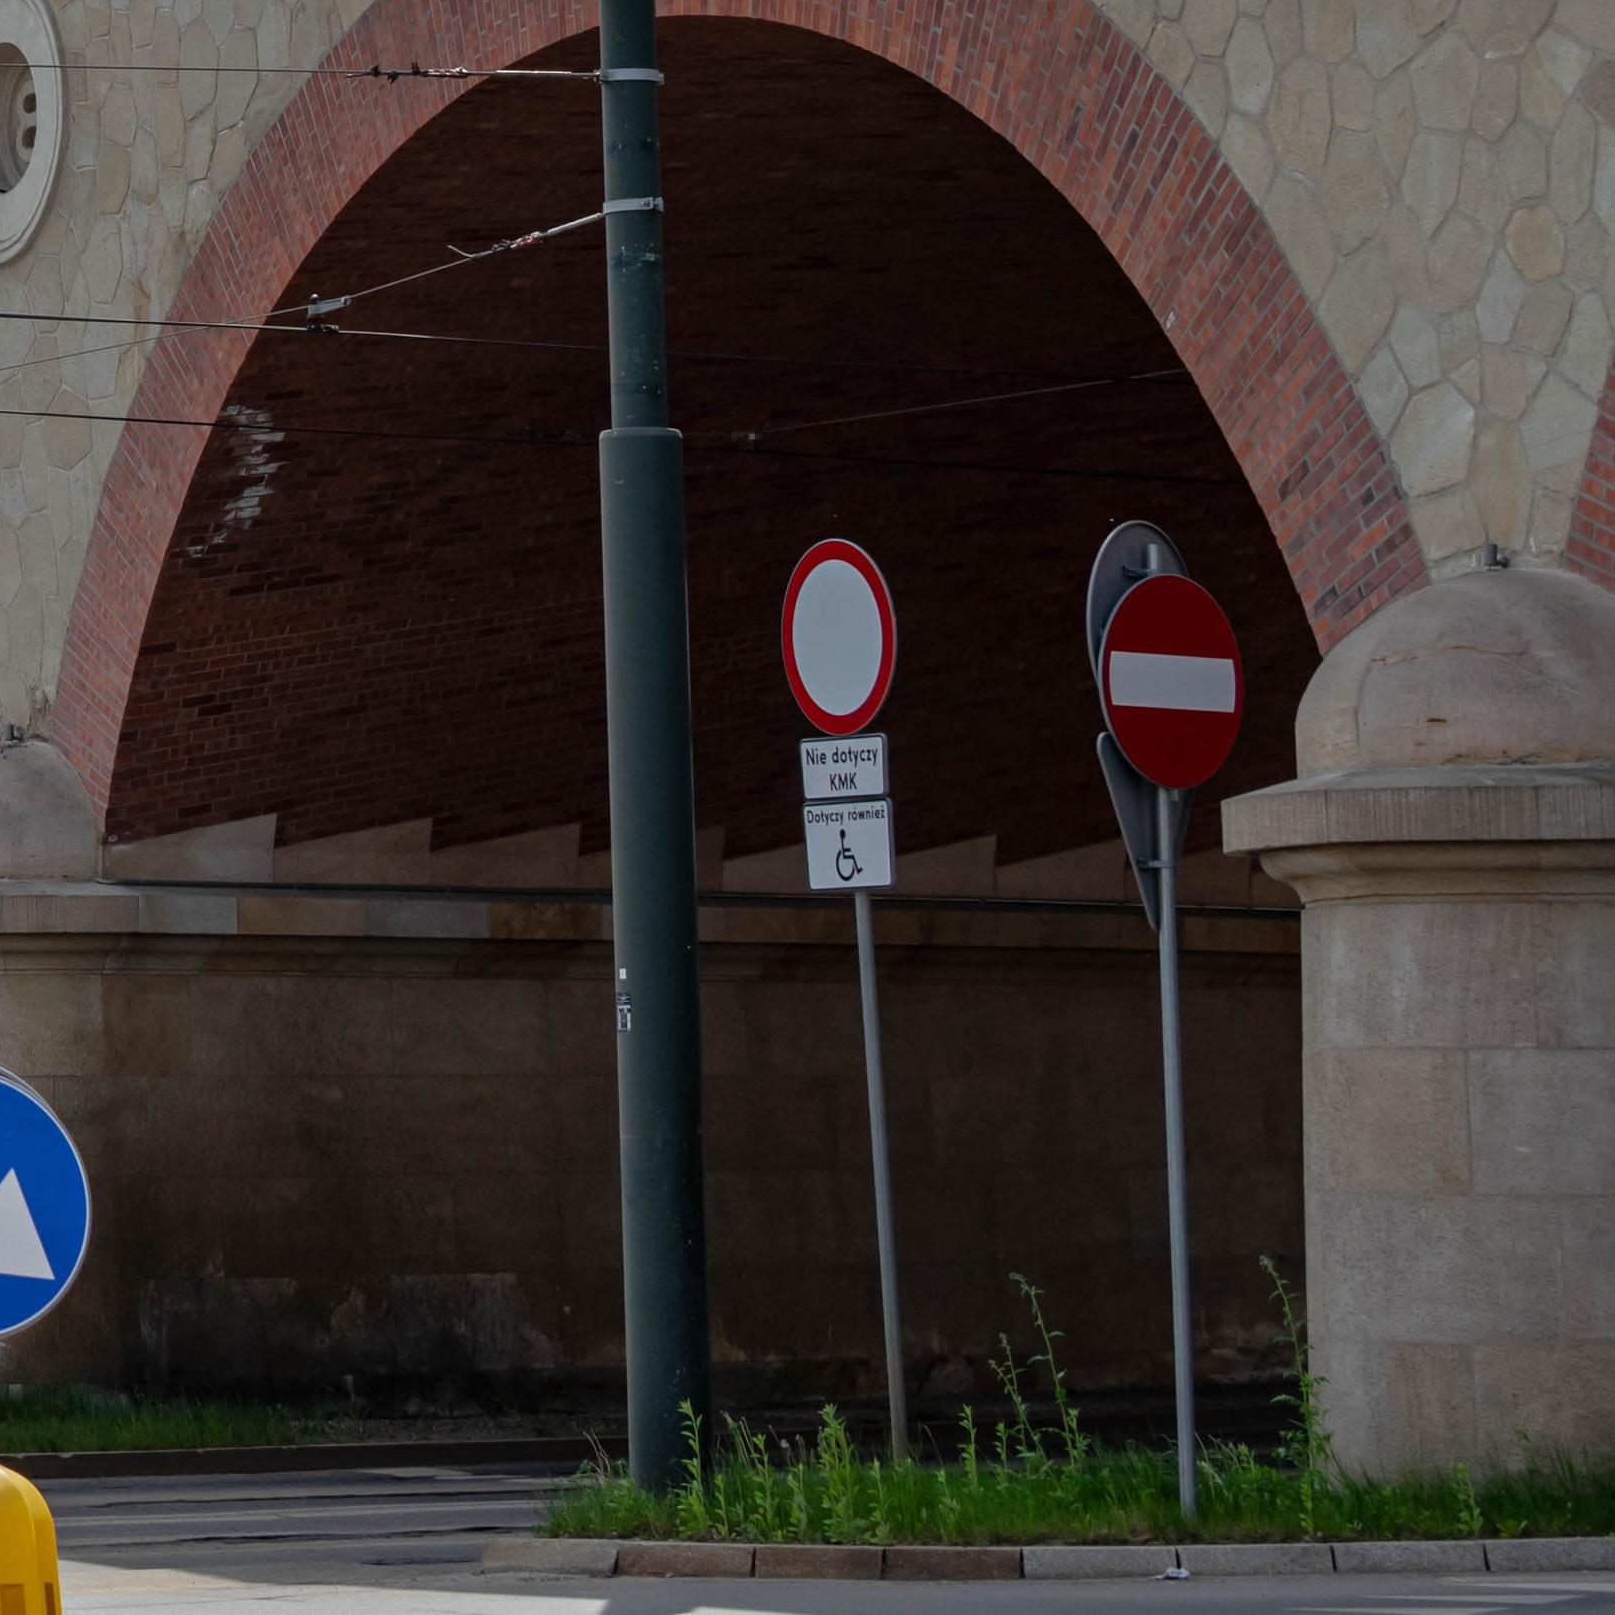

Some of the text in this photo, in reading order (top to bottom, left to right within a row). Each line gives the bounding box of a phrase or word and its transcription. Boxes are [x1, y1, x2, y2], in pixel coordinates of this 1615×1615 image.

[805, 746, 878, 768] Nie dotyczy
[829, 771, 858, 792] KMK
[806, 805, 886, 827] Dotyczy również
